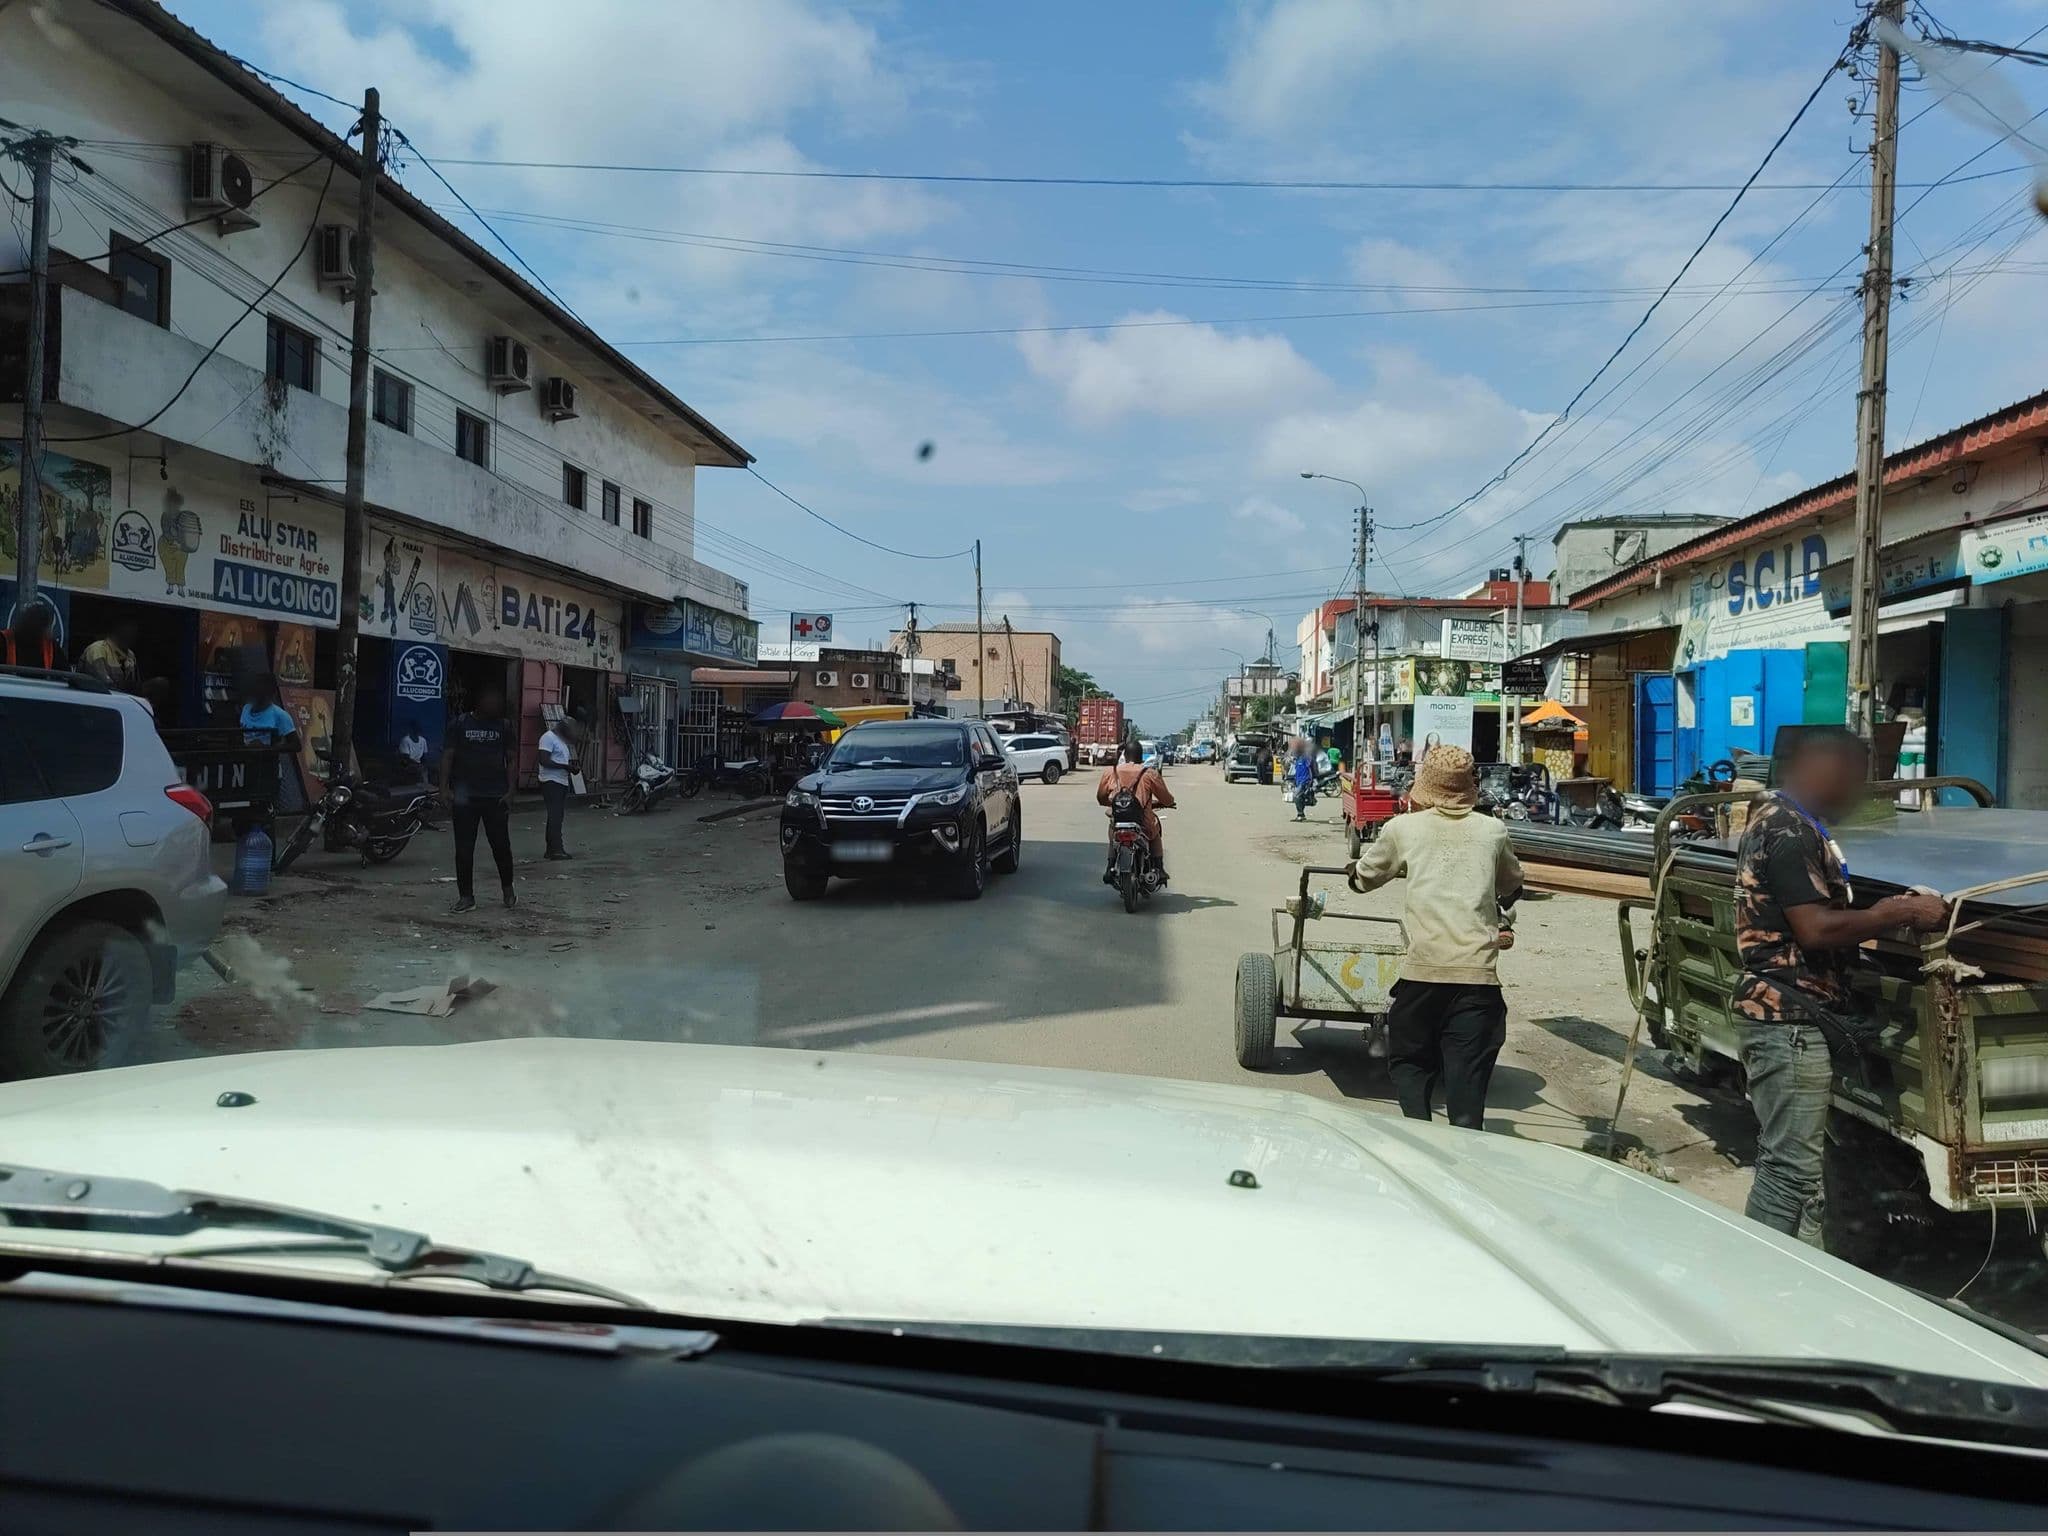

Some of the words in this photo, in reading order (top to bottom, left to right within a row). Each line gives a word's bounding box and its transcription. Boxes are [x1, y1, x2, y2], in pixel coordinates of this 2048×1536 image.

[237, 512, 272, 541] ALU
[276, 521, 318, 553] STAR
[219, 534, 295, 568] Distributeur
[299, 553, 330, 576] Agrée
[1727, 534, 1828, 616] S.C.I.D
[217, 566, 335, 615] ALUCONGO
[564, 602, 596, 642] 24
[1451, 633, 1488, 646] EXPRESS
[402, 686, 436, 696] ALUCONGO
[1430, 703, 1457, 711] momo
